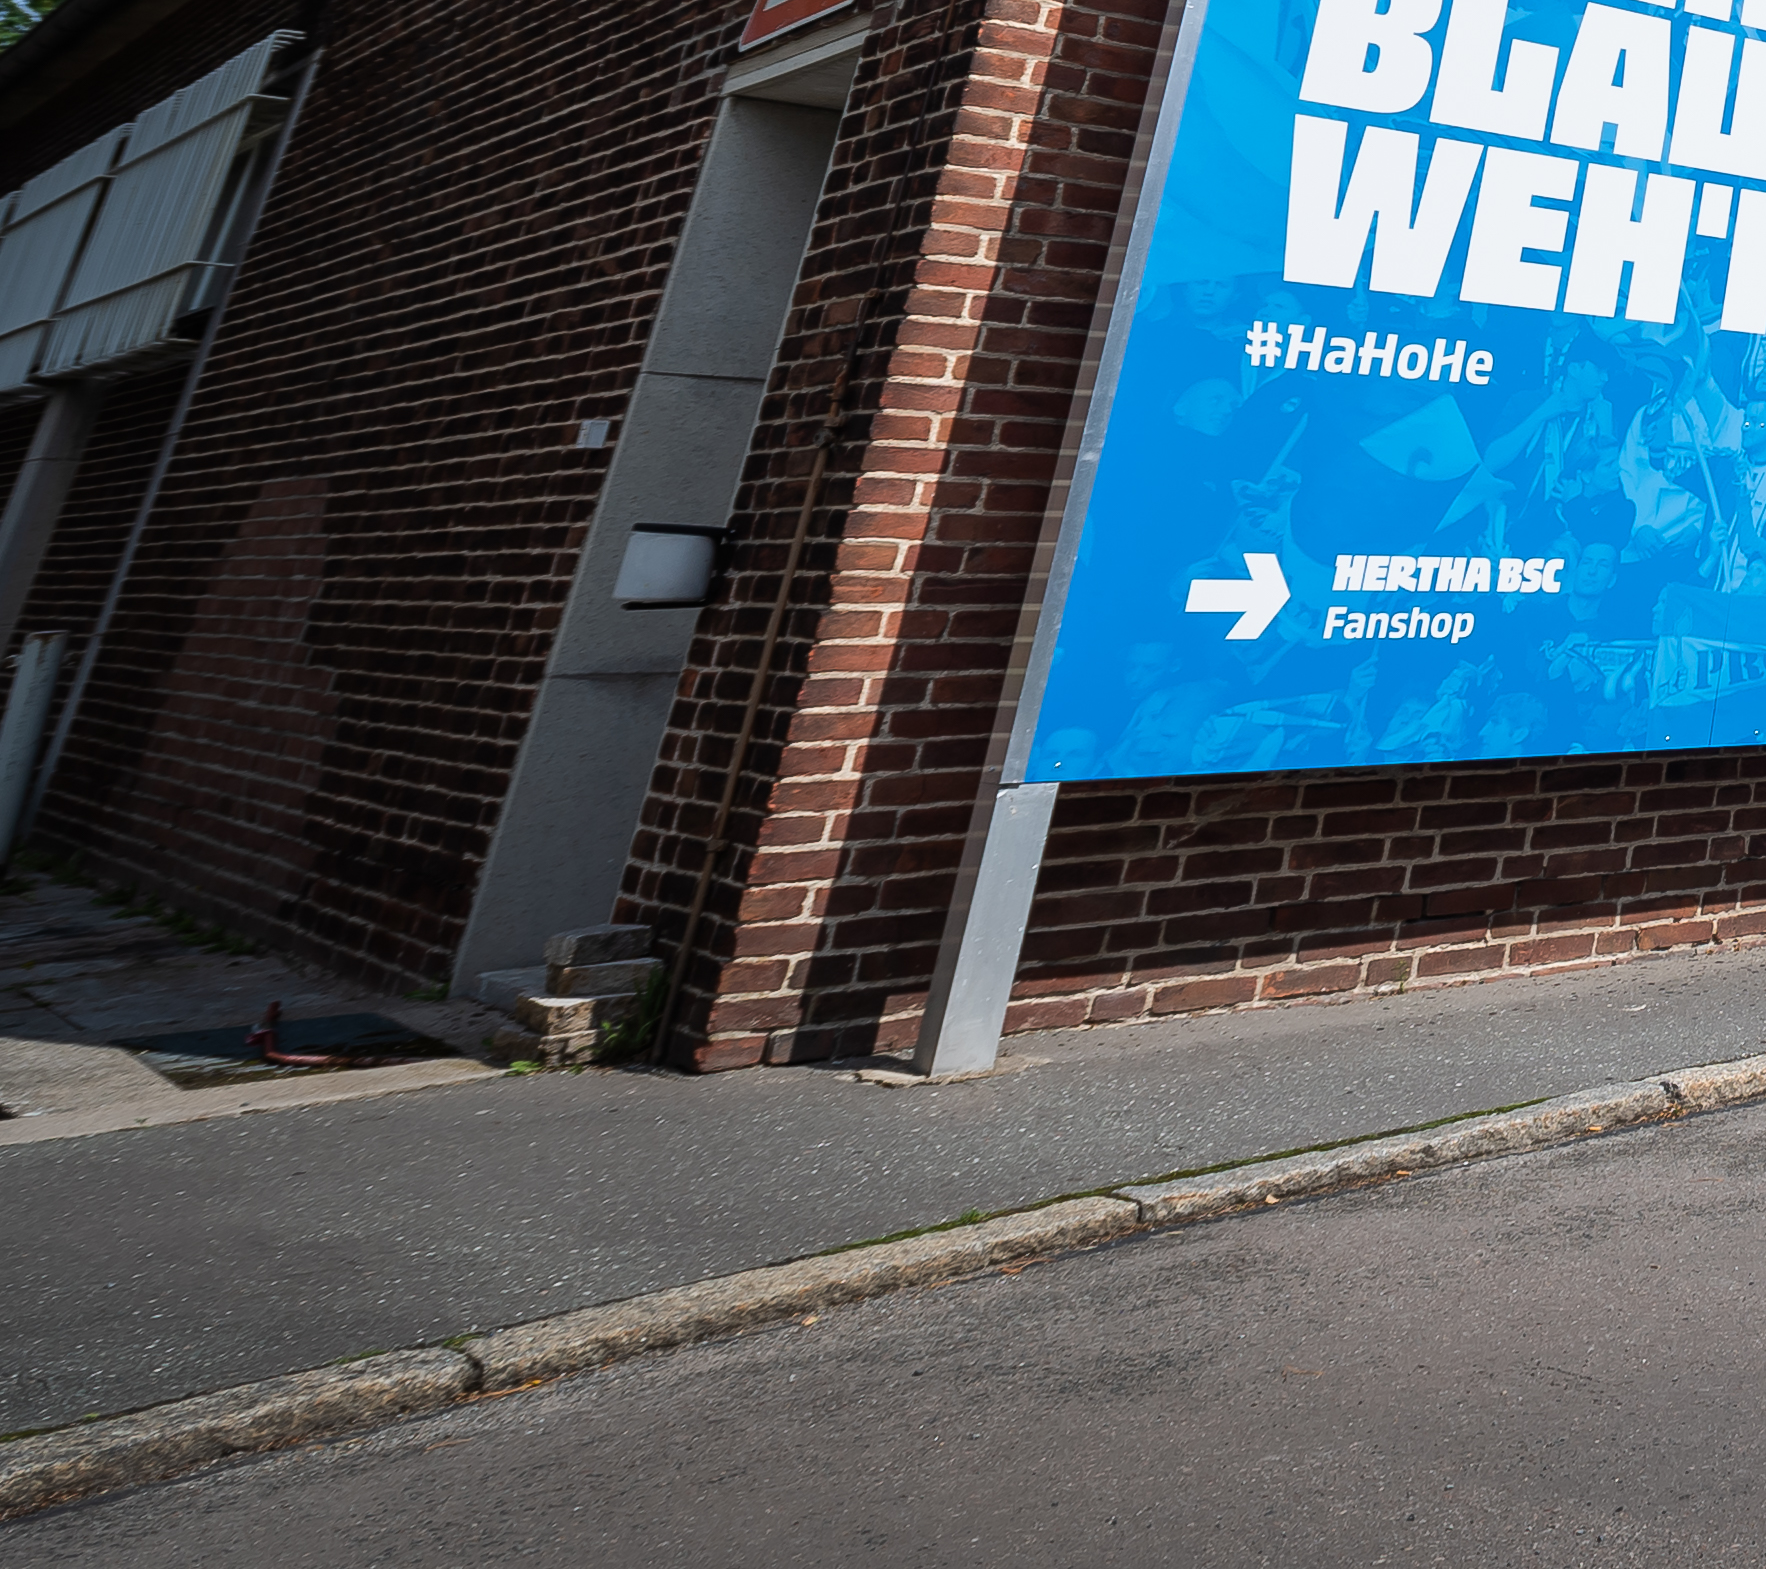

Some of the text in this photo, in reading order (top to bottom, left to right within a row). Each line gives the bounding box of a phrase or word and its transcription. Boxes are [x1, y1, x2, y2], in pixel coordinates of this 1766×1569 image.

[1245, 321, 1494, 385] #HaHoHe
[1332, 555, 1565, 593] HERTHA BSC
[1323, 606, 1474, 644] Fanshop
